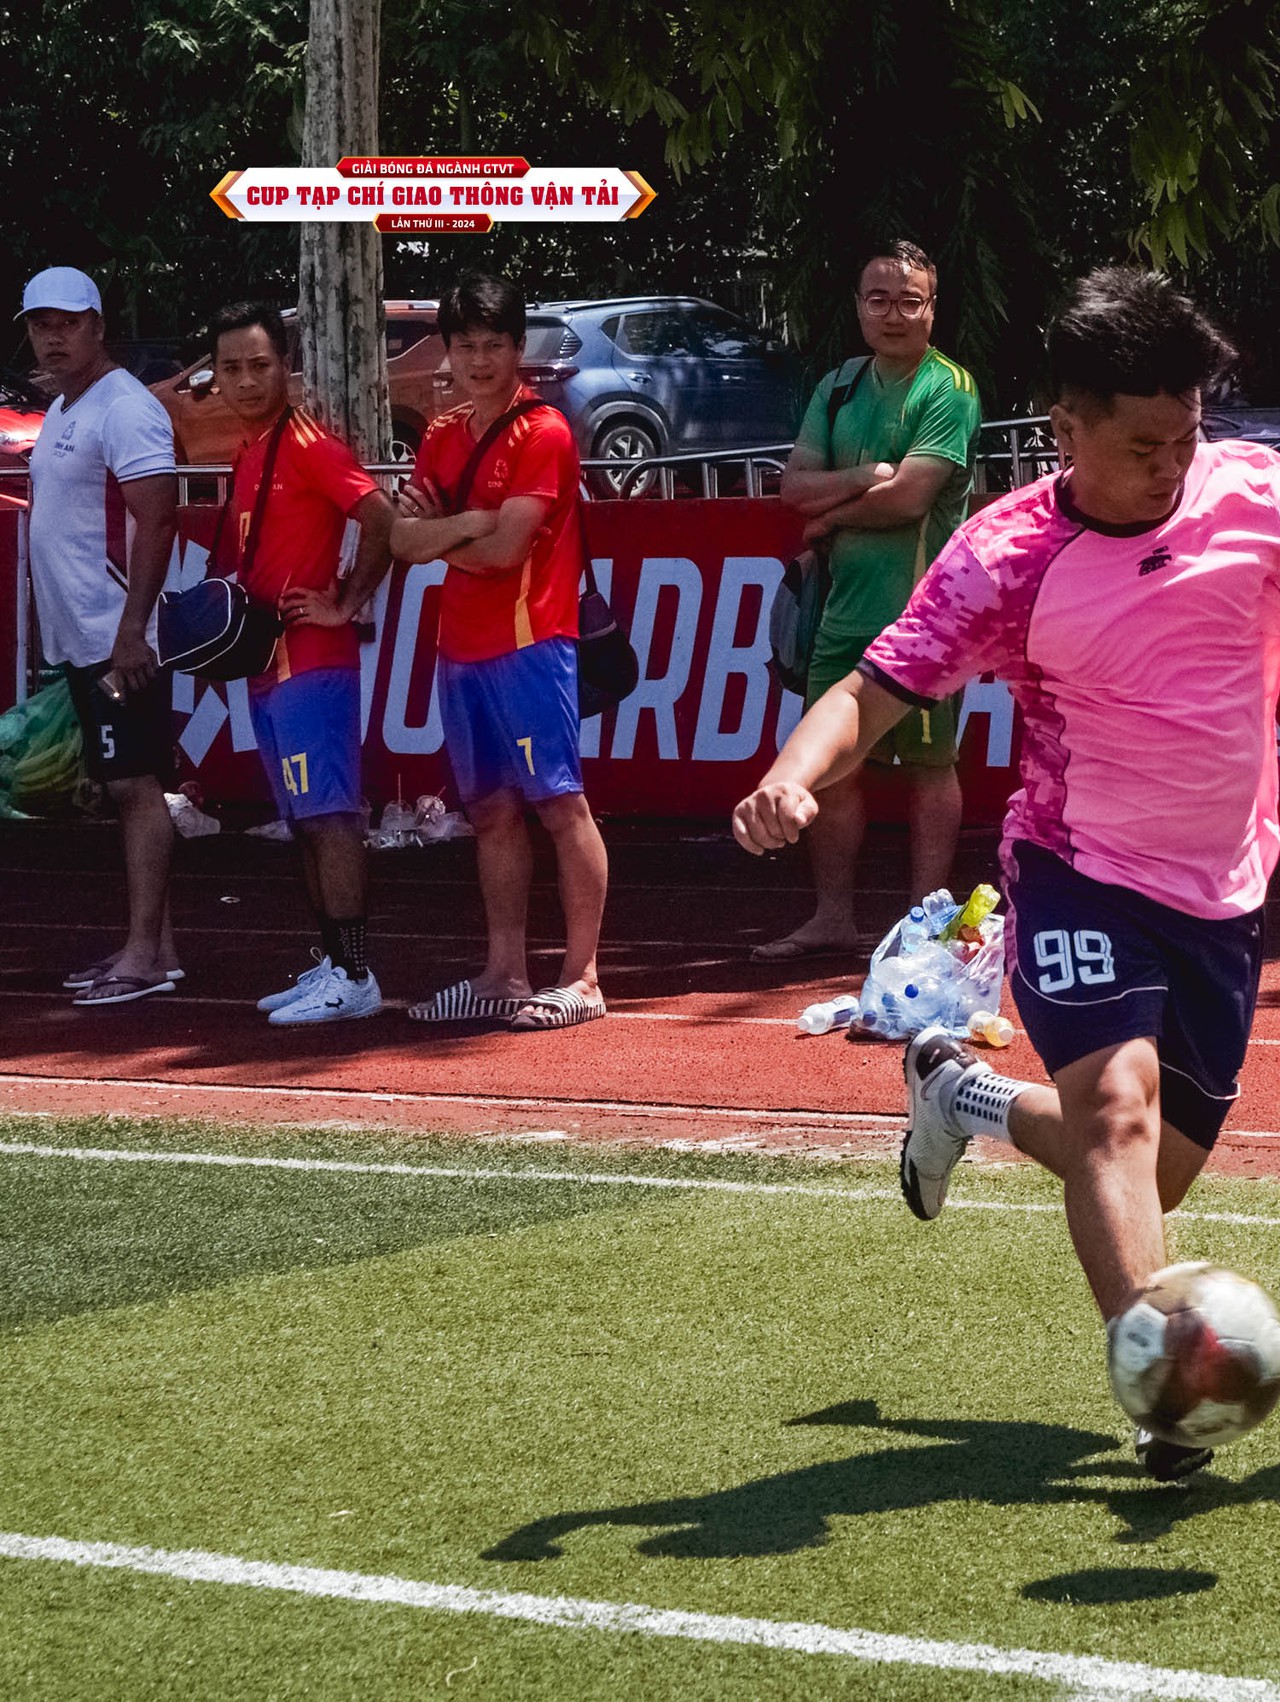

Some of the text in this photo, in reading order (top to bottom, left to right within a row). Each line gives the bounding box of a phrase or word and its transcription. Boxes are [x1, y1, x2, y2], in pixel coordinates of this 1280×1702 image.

[101, 724, 116, 759] 5
[516, 736, 536, 776] 7
[282, 752, 310, 796] 47
[1033, 929, 1116, 994] 99
